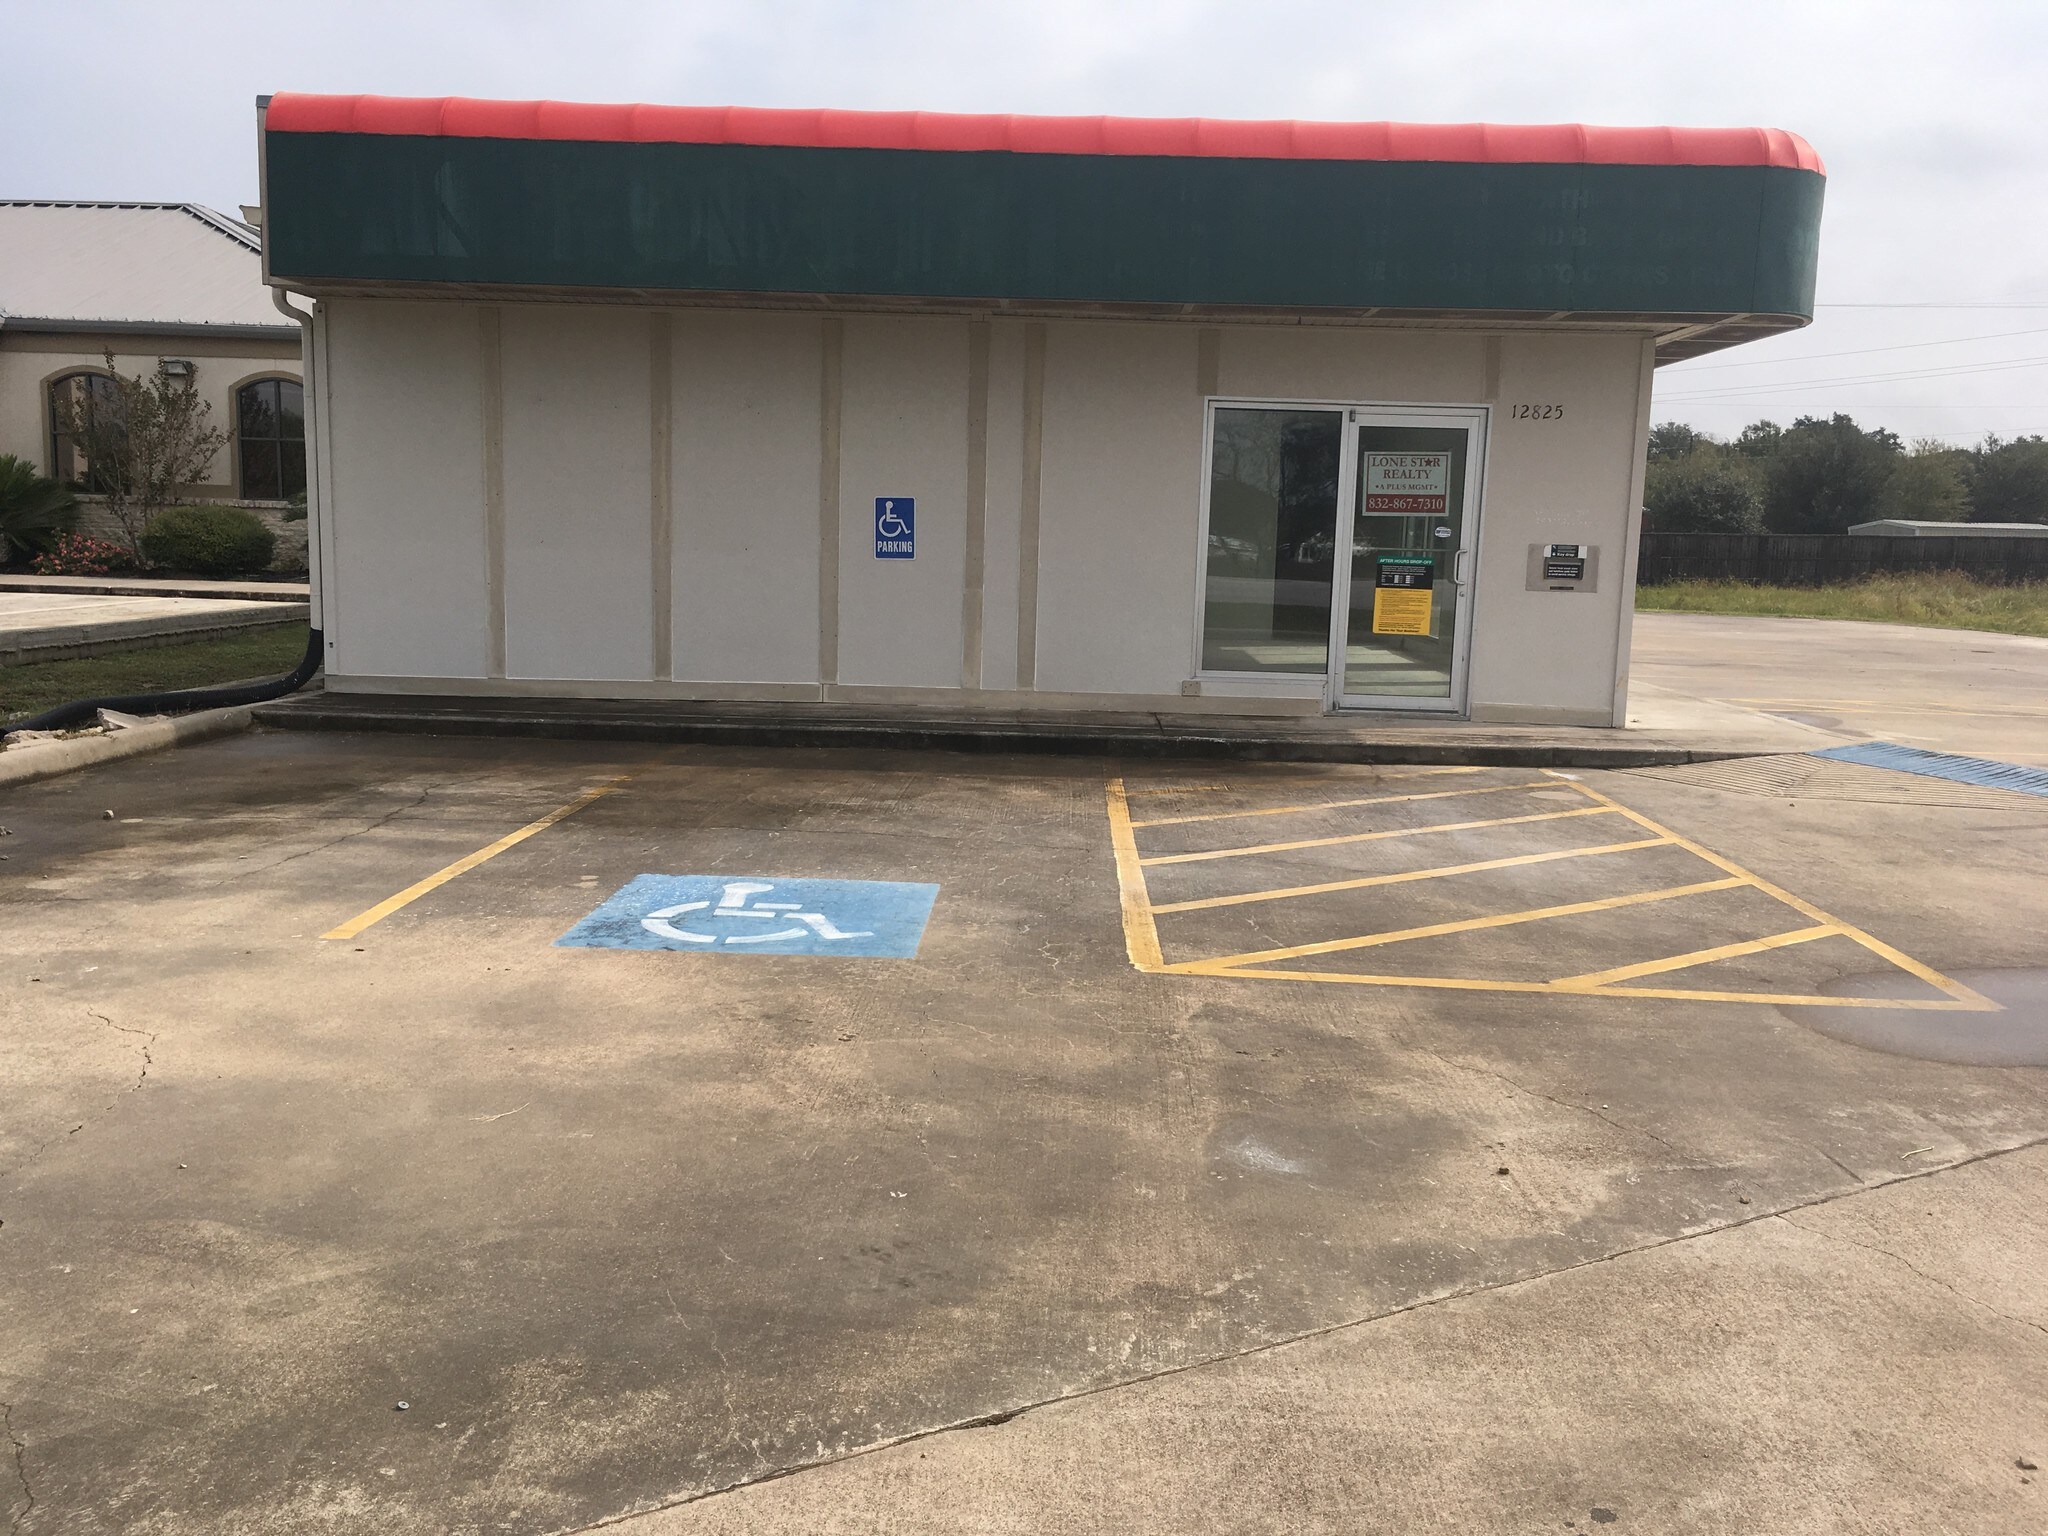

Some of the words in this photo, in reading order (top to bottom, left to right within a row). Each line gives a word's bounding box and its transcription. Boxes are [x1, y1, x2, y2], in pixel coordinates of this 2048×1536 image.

[1512, 404, 1563, 420] 12825
[1372, 457, 1408, 467] LONE
[1383, 469, 1433, 479] REALTY
[1368, 498, 1443, 510] 832-867-7310
[877, 541, 913, 553] PARKING
